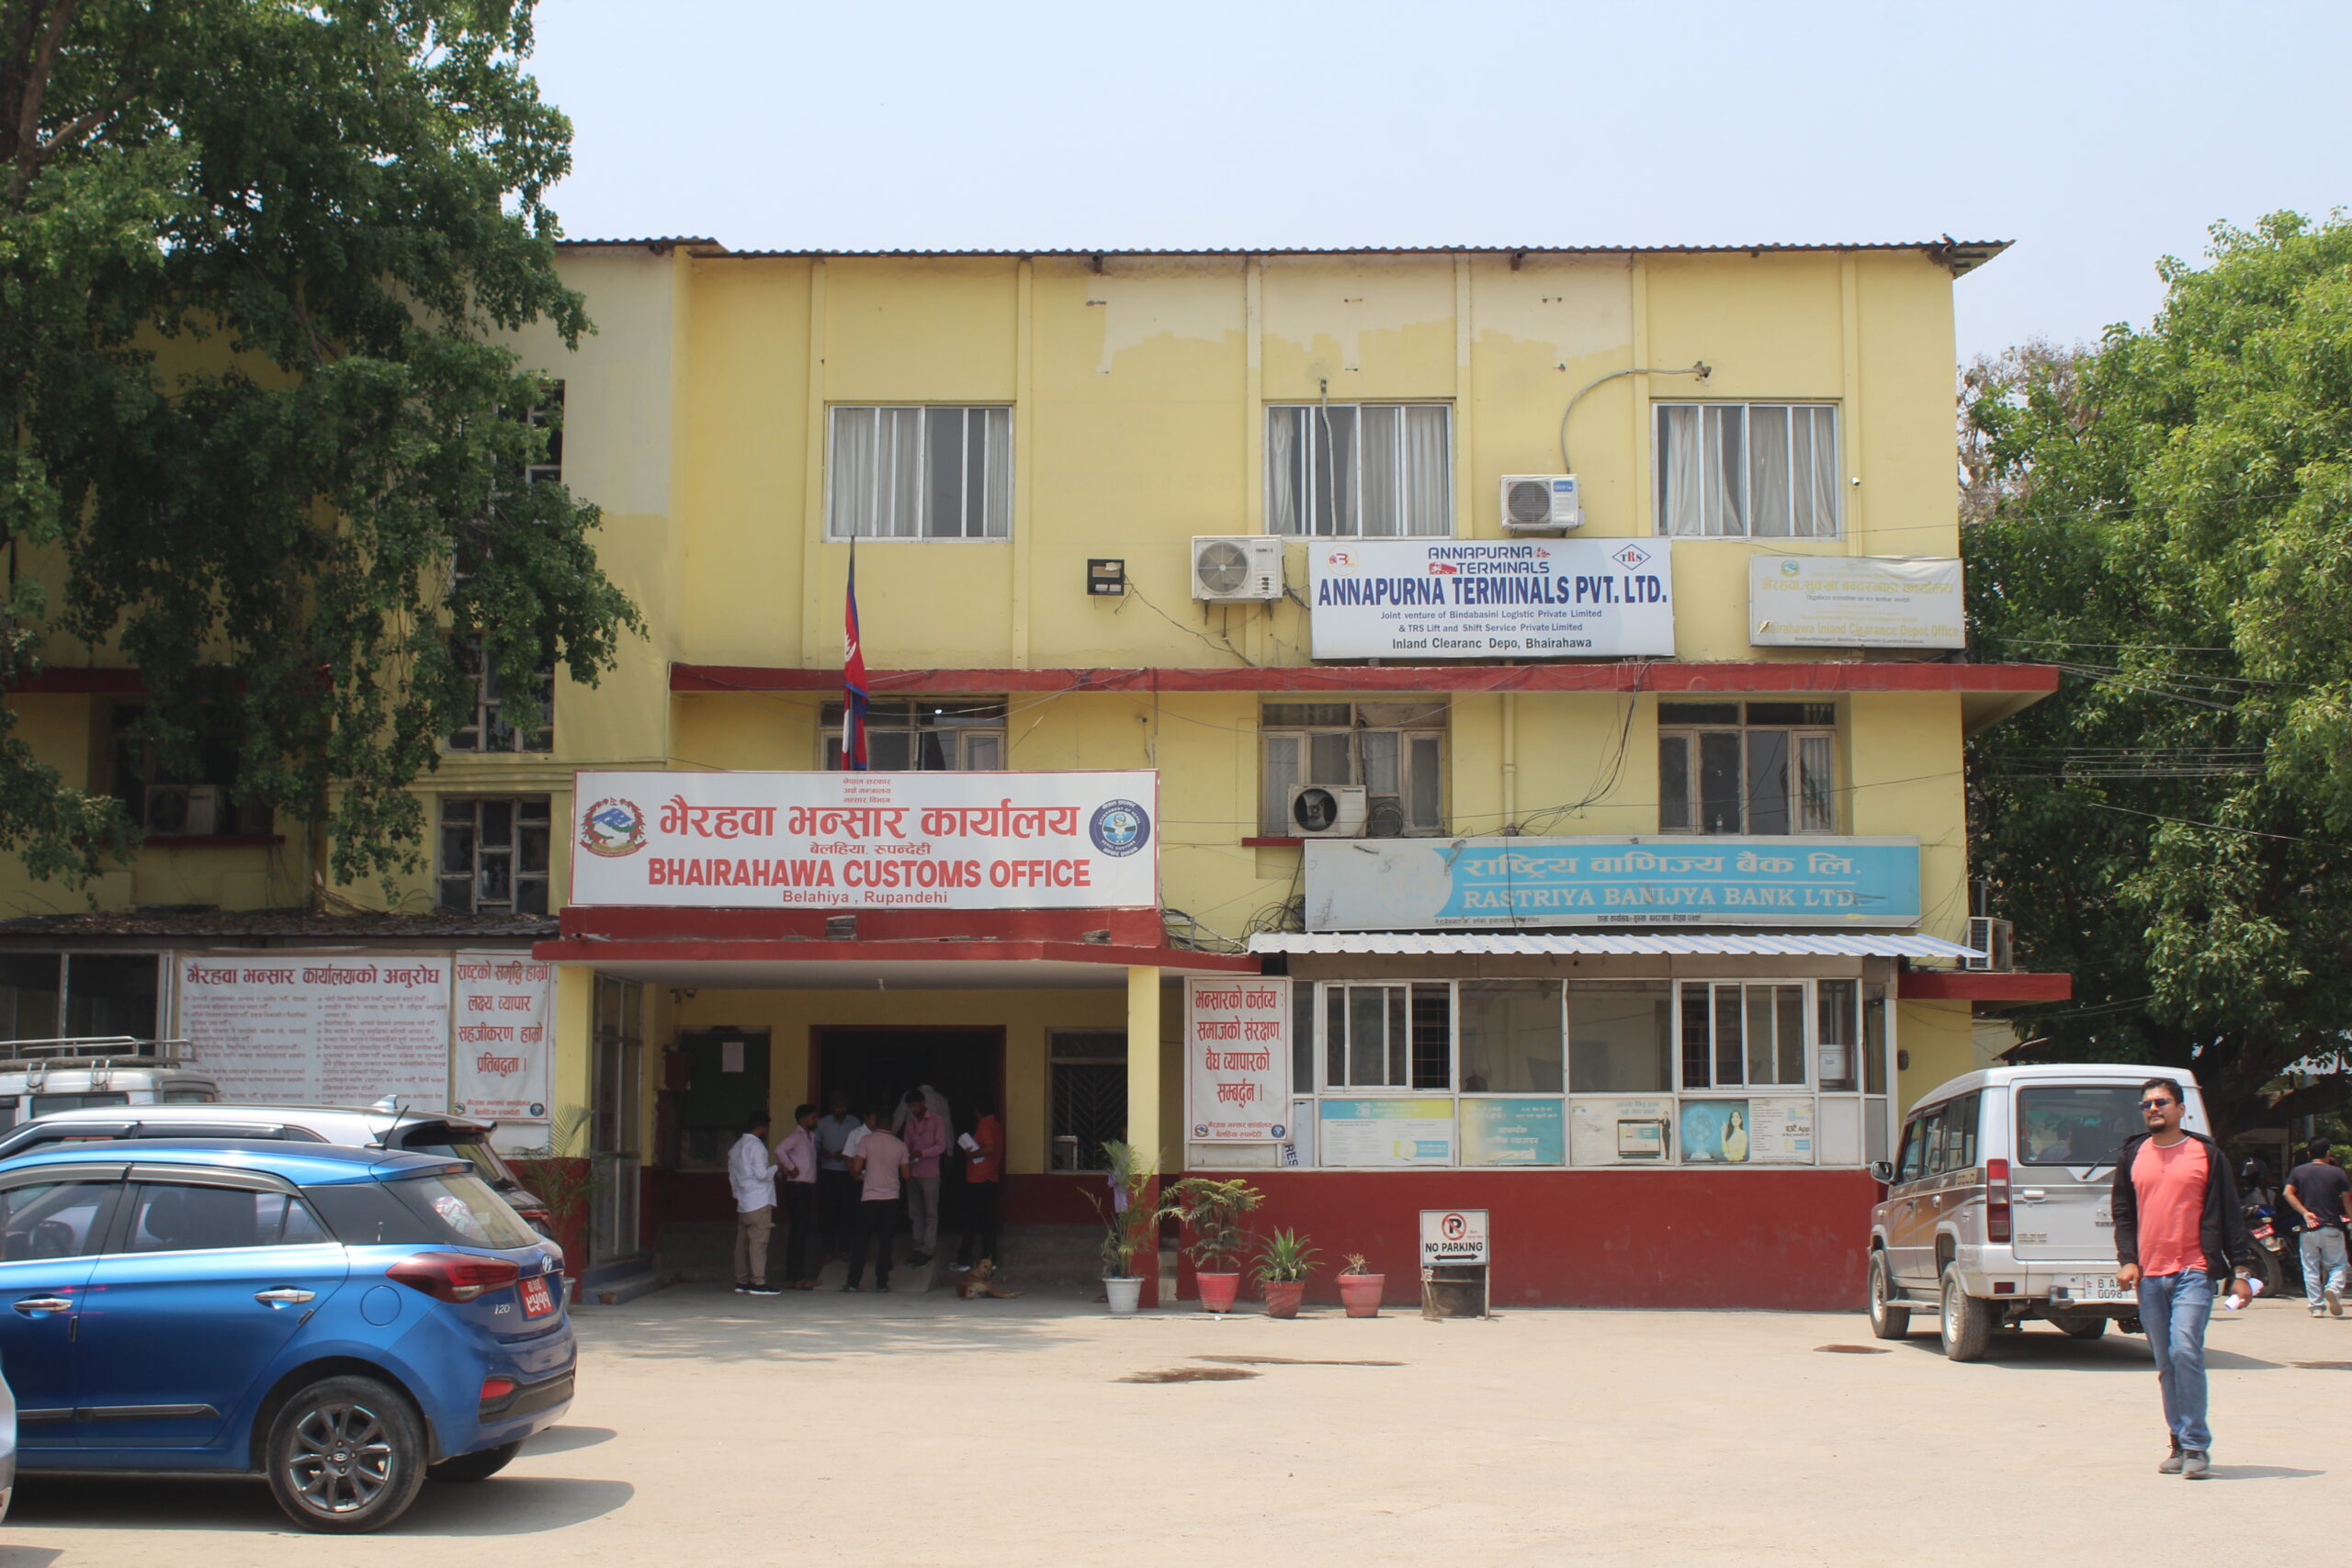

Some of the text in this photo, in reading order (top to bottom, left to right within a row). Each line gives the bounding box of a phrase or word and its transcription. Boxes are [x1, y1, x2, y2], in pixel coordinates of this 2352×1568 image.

[1429, 547, 1532, 559] ANNAPURNA
[1620, 551, 1643, 561] TRS
[1456, 561, 1550, 574] TERMINALS
[1318, 575, 1667, 606] ANNAPURNA TERMINALS PVT. LTD.
[1381, 611, 1401, 619] Joint
[1438, 610, 1446, 618] of
[1449, 610, 1498, 618] Bindabasini
[1501, 610, 1534, 620] Logistic
[1538, 609, 1566, 618] Private
[1570, 609, 1602, 618] Limited
[1398, 623, 1583, 633] & TRS Lift and Shift Service Private Limited
[1392, 637, 1592, 650] Inland Clearanc Depo, Bhairahawa
[660, 794, 1080, 840] भैरहवा भन्सार कार्यालय
[1590, 851, 1725, 874] वाणिज्य
[648, 858, 1091, 888] BHAIRAHAWA CUSTOMS OFFICE
[783, 890, 849, 906] Belahiya
[865, 890, 948, 906] Rupandehi
[1464, 887, 1595, 908] RASTRIYA
[1603, 886, 1716, 906] BANIJYA
[1724, 887, 1797, 907] BANK
[187, 963, 238, 986] भैरहवा
[243, 967, 297, 986] भन्सार
[382, 964, 441, 988] अनुरोध
[498, 995, 532, 1012] व्यापार
[1195, 985, 1243, 1010] भन्सारको
[458, 1021, 514, 1043] सहजीकरण
[1196, 1015, 1242, 1042] समाजको
[1223, 1045, 1271, 1073] व्यापारको
[1425, 1241, 1484, 1253] NO PARKING
[2098, 1279, 2104, 1289] B
[2098, 1289, 2123, 1299] 0098
